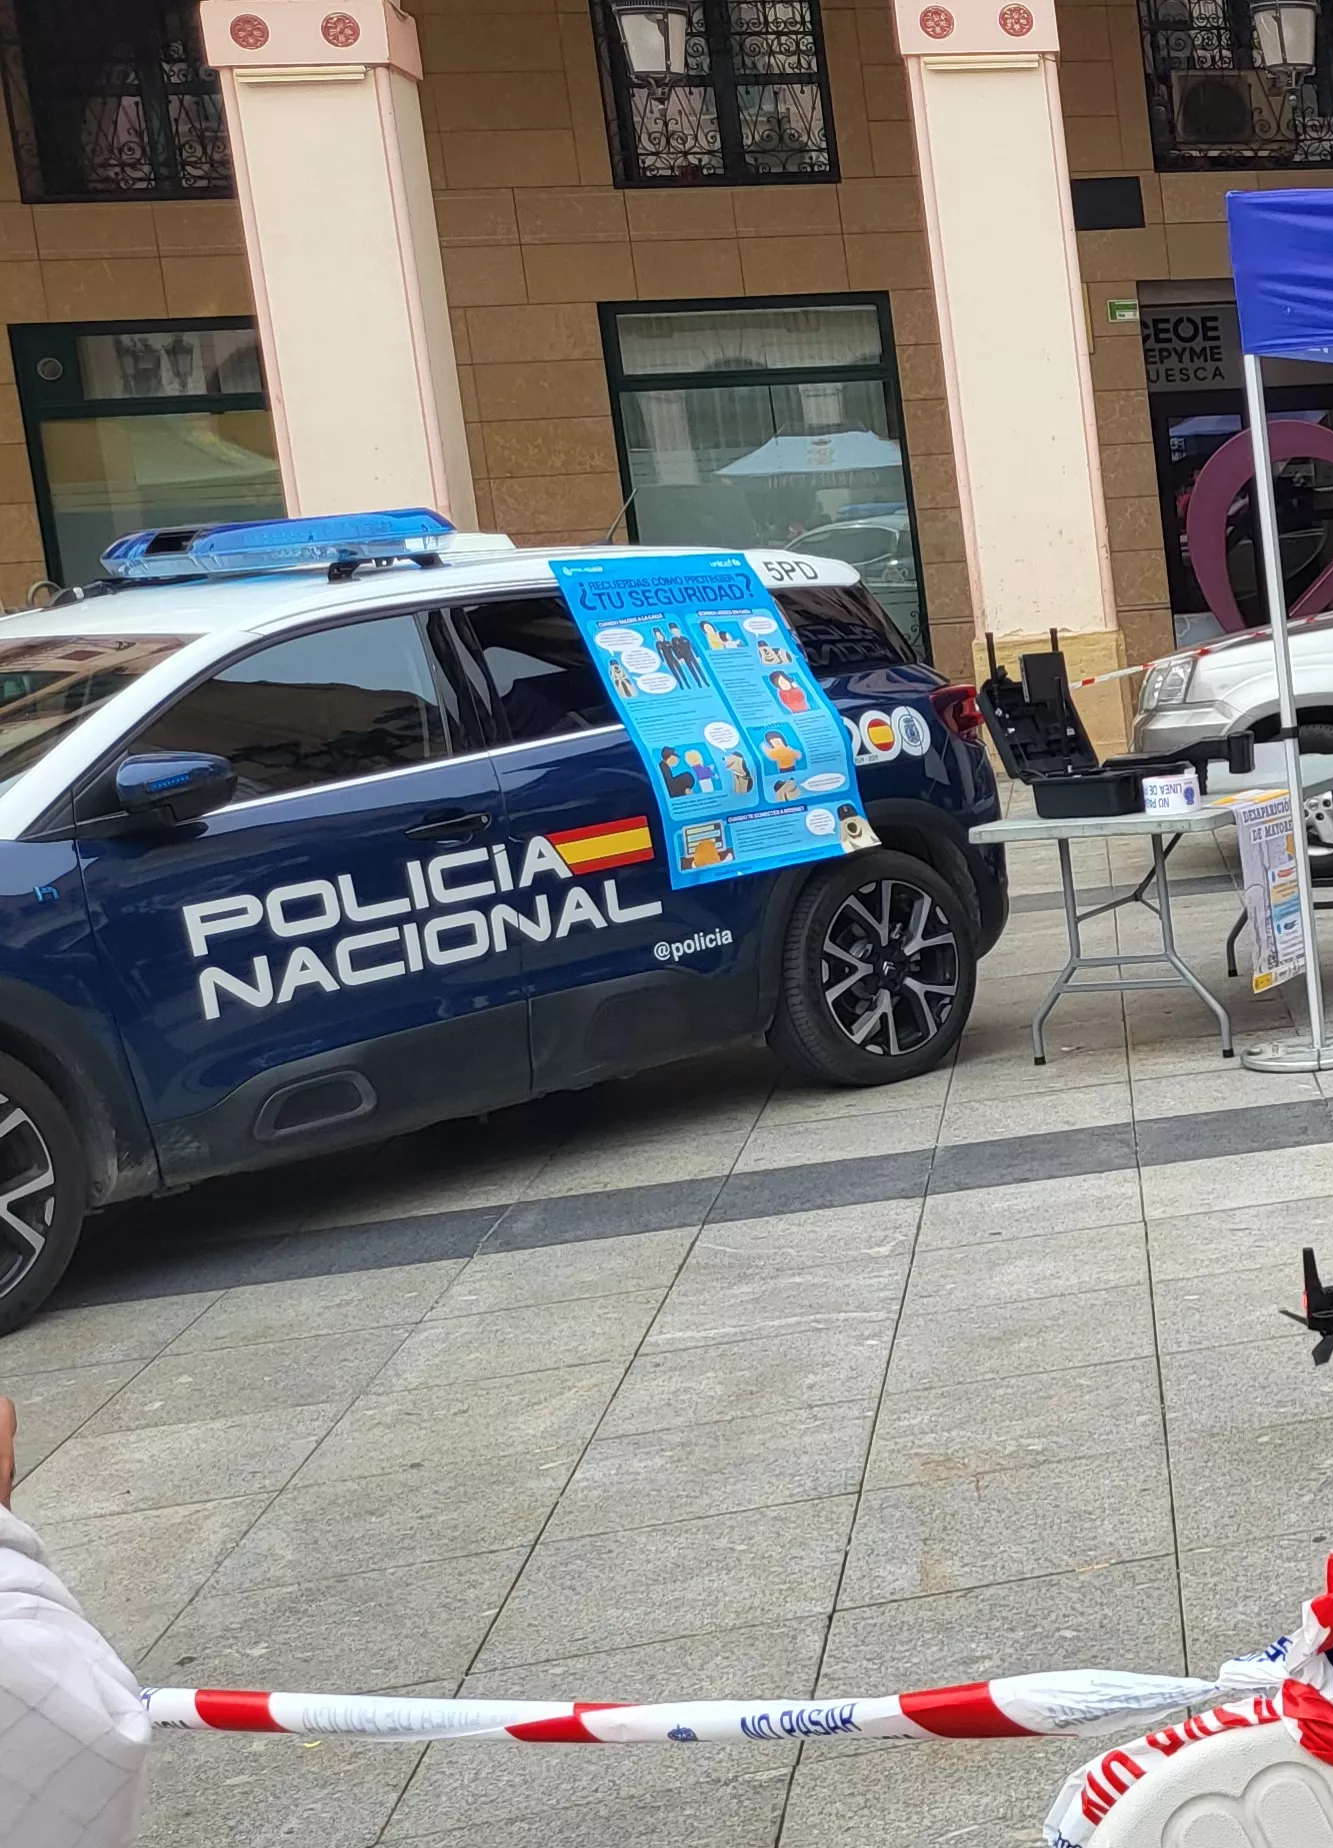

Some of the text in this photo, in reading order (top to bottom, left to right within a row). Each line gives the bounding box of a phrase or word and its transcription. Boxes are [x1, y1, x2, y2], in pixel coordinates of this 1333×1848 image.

[1144, 345, 1223, 365] EPYME
[1147, 366, 1226, 384] UESCA
[762, 560, 819, 582] 5PD
[1242, 798, 1290, 824] DESAPARICIÓ
[1265, 819, 1293, 839] MAYORE
[199, 879, 663, 1020] NACIONAL
[653, 928, 734, 964] @policia
[740, 1702, 863, 1741] NO PASAR
